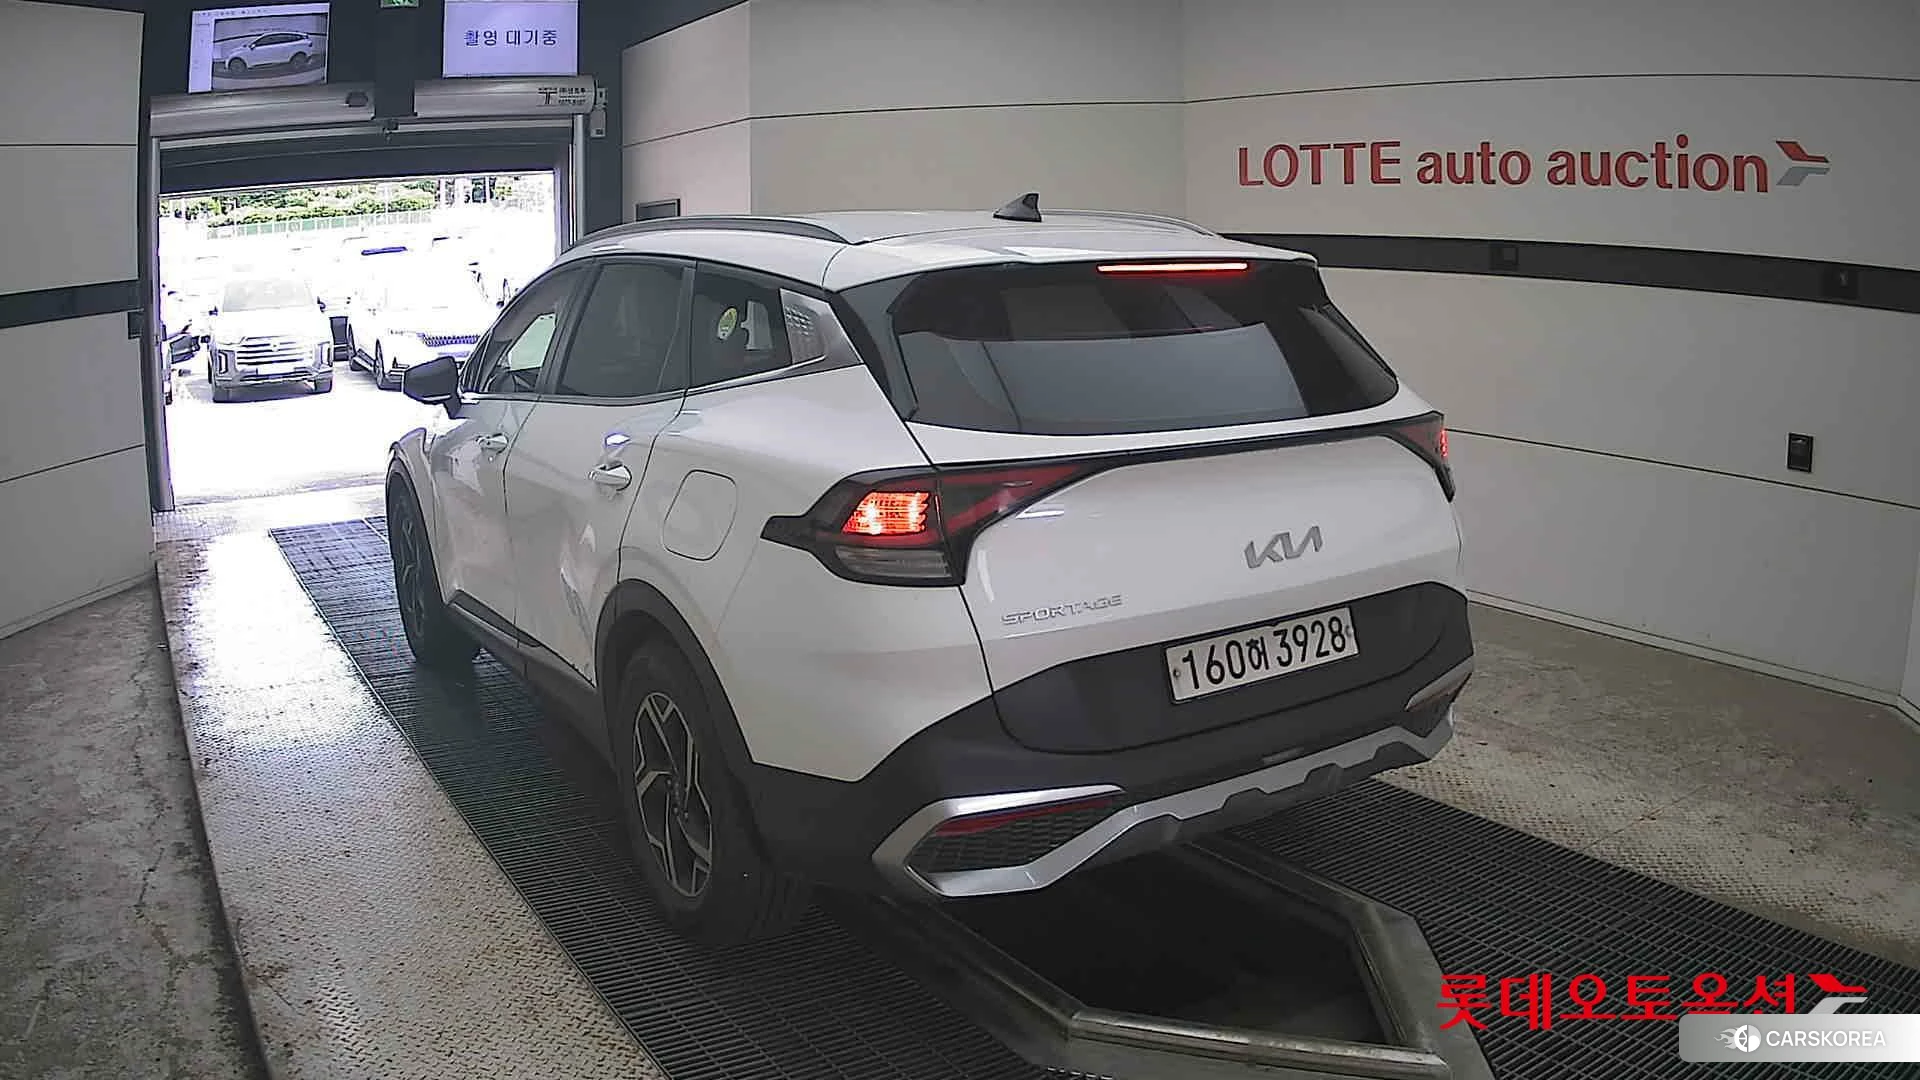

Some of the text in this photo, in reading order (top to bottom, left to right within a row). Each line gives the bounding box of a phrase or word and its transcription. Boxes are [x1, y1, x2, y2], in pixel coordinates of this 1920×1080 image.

[506, 30, 558, 46] 대기중
[1239, 133, 1769, 193] LOTTE auto auction
[1001, 594, 1123, 626] SPORTAGE
